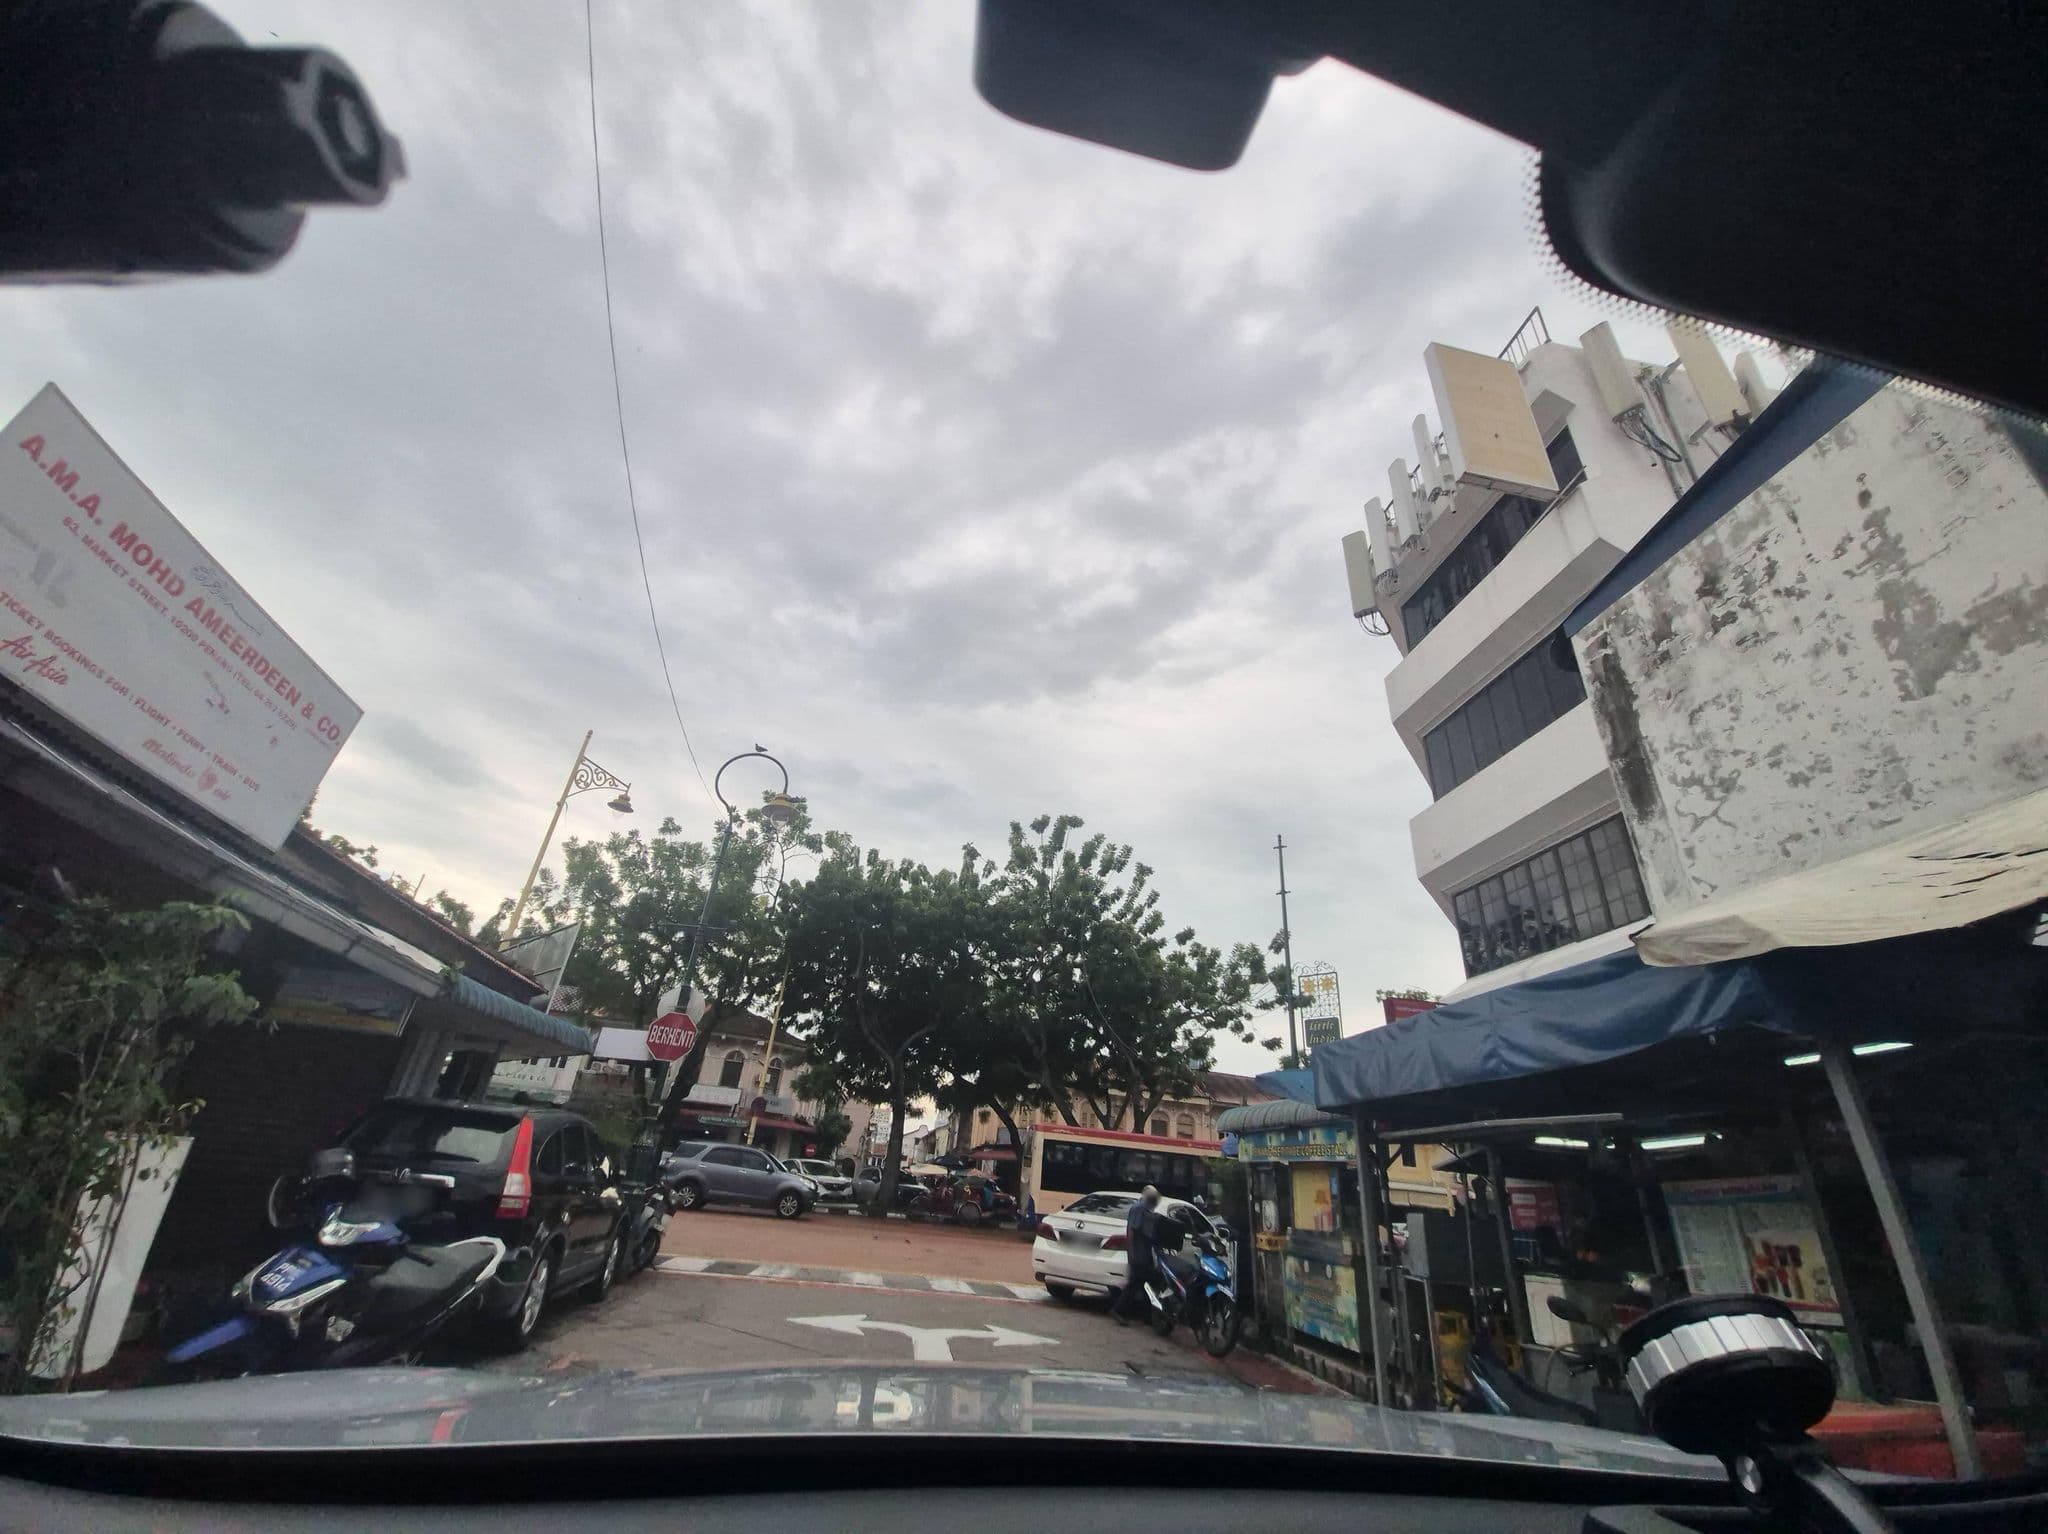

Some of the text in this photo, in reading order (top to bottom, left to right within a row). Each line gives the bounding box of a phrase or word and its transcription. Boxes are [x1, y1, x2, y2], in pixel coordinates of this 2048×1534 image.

[19, 434, 103, 526] A.M.A.
[109, 521, 185, 597] MOHD
[184, 597, 302, 707] AMEERDEEN
[301, 702, 315, 719] &
[81, 534, 129, 577] MARKET
[0, 591, 45, 630] TICKET
[44, 629, 105, 679] BOOKINGS
[133, 697, 171, 728] FLIGHT
[649, 1025, 695, 1049] BERHENTI
[1310, 1020, 1335, 1031] Little
